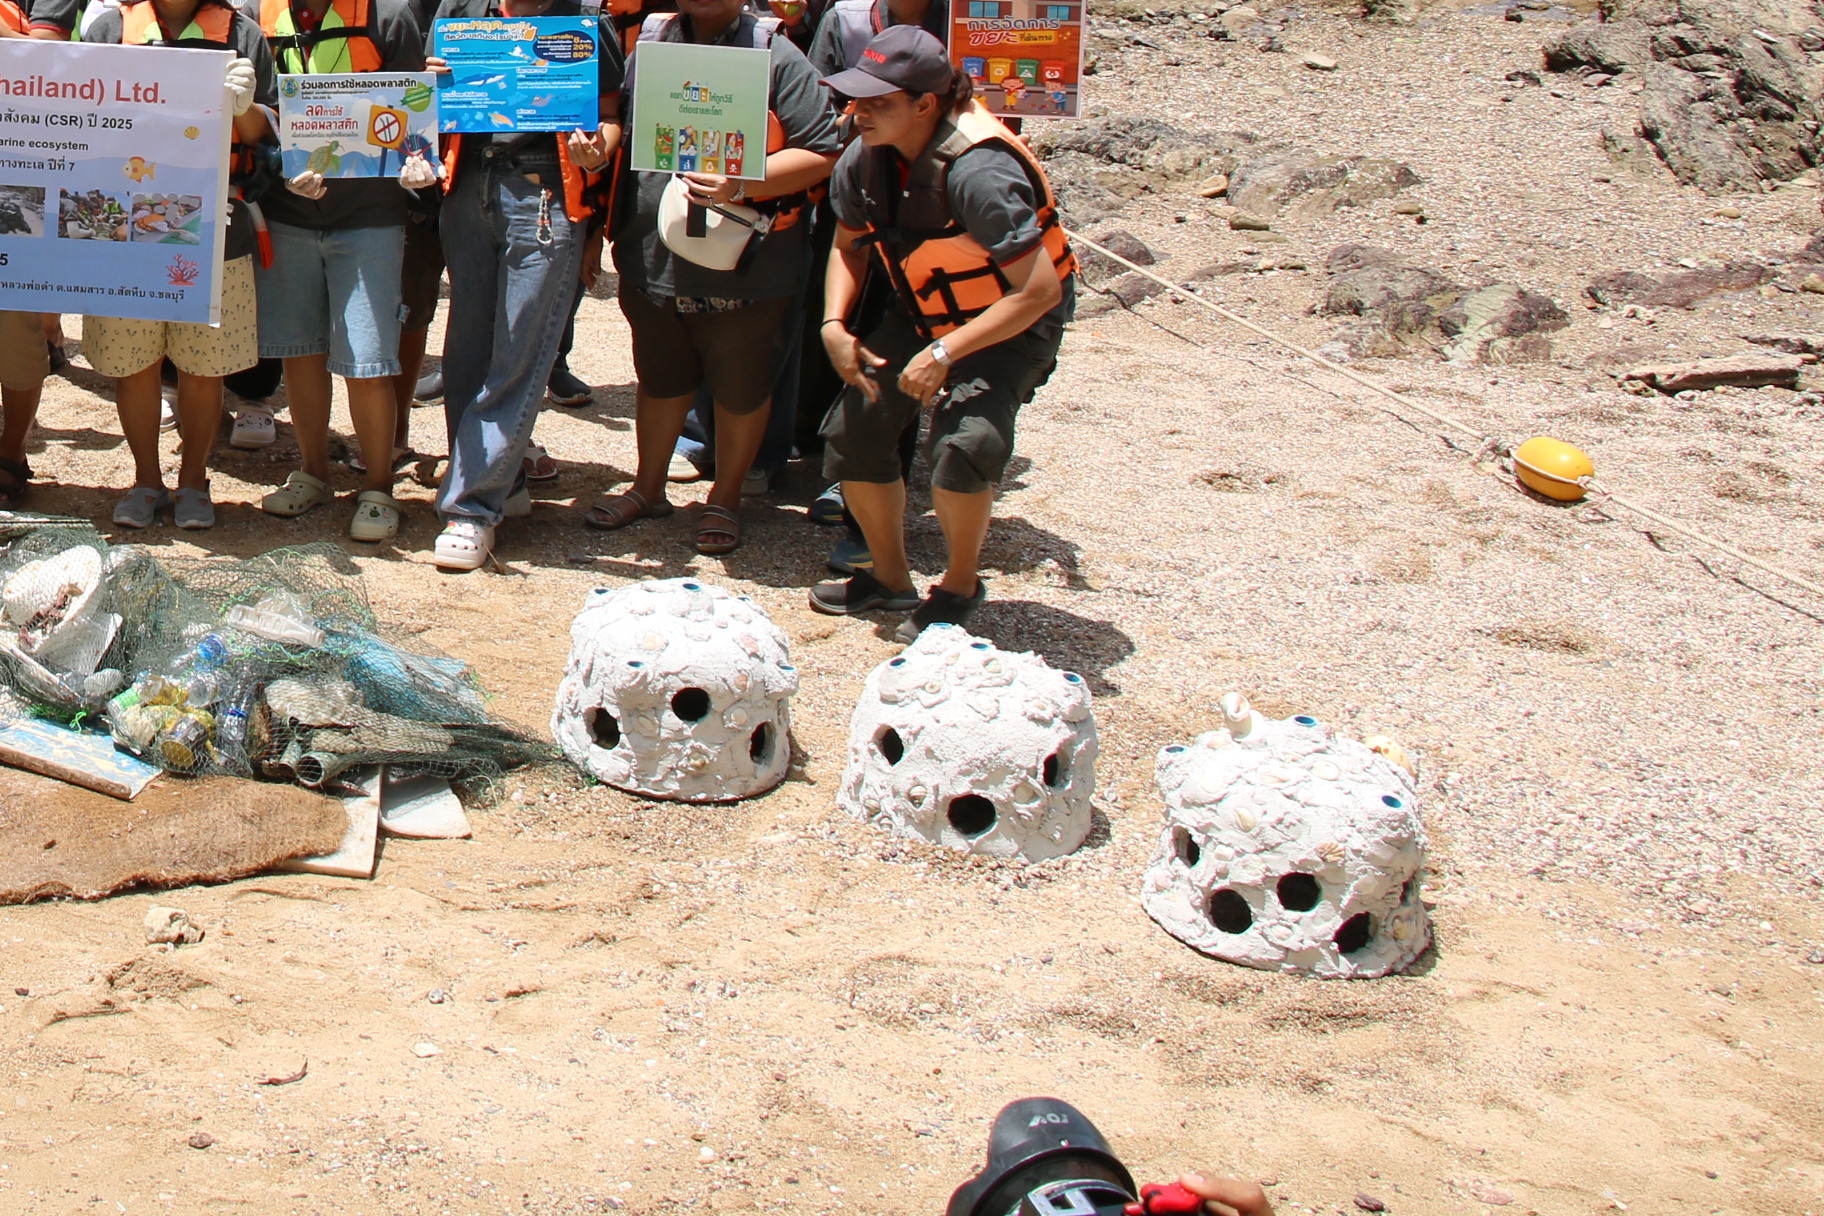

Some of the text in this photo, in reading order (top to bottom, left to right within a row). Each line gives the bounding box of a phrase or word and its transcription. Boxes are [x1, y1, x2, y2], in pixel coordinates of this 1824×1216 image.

[968, 15, 1061, 31] การจัดการ
[969, 31, 1018, 46] ขยะ
[300, 78, 417, 90] ร่วมลดการใช้หลอดพลาสติก
[115, 80, 166, 104] Ltd.
[44, 114, 84, 128] (CSR)
[87, 113, 97, 128] ปี
[101, 117, 133, 130] 2025
[291, 118, 359, 131] หลอดพลาสติก
[28, 140, 89, 152] ecosystem
[69, 162, 75, 172] 7
